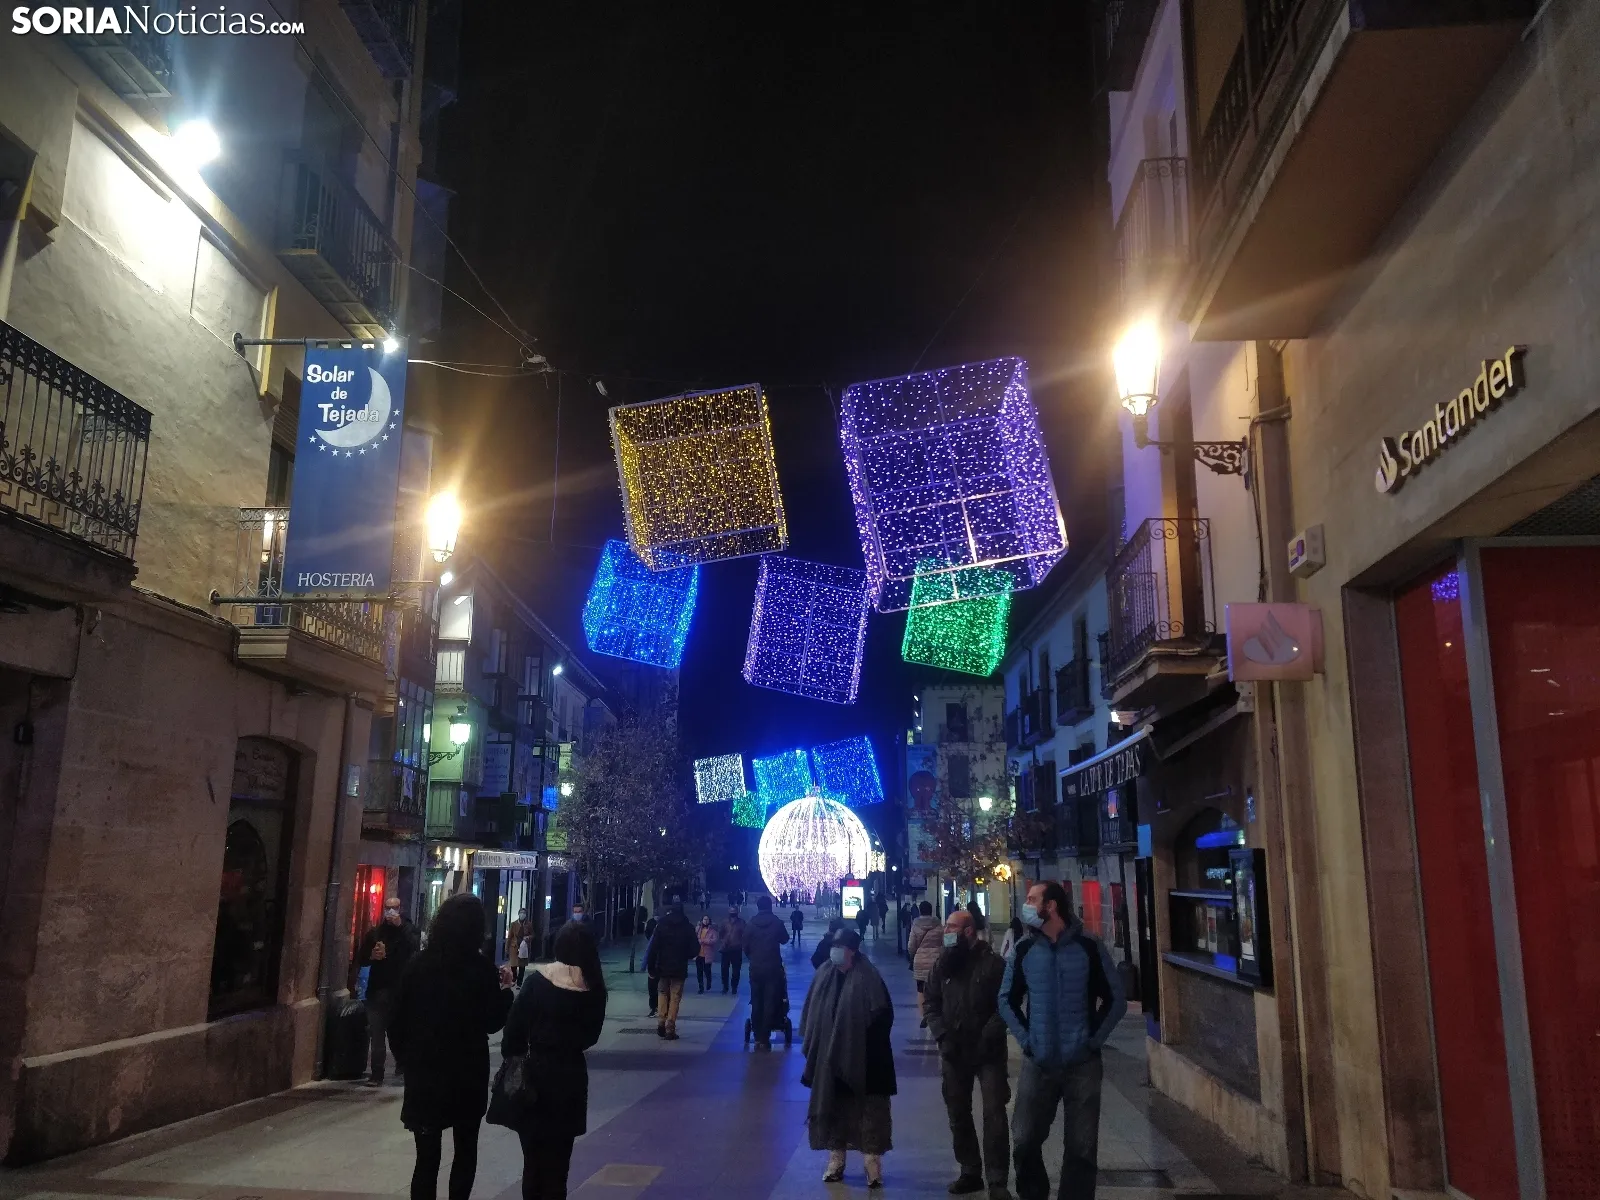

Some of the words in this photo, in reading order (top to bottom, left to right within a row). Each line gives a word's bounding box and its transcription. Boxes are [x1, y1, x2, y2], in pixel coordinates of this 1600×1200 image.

[306, 364, 355, 383] Solar
[330, 386, 348, 400] de
[317, 403, 380, 428] Tejada
[1400, 345, 1517, 477] Santander
[297, 572, 375, 587] HOSTERIA
[1115, 744, 1141, 785] TAPAS
